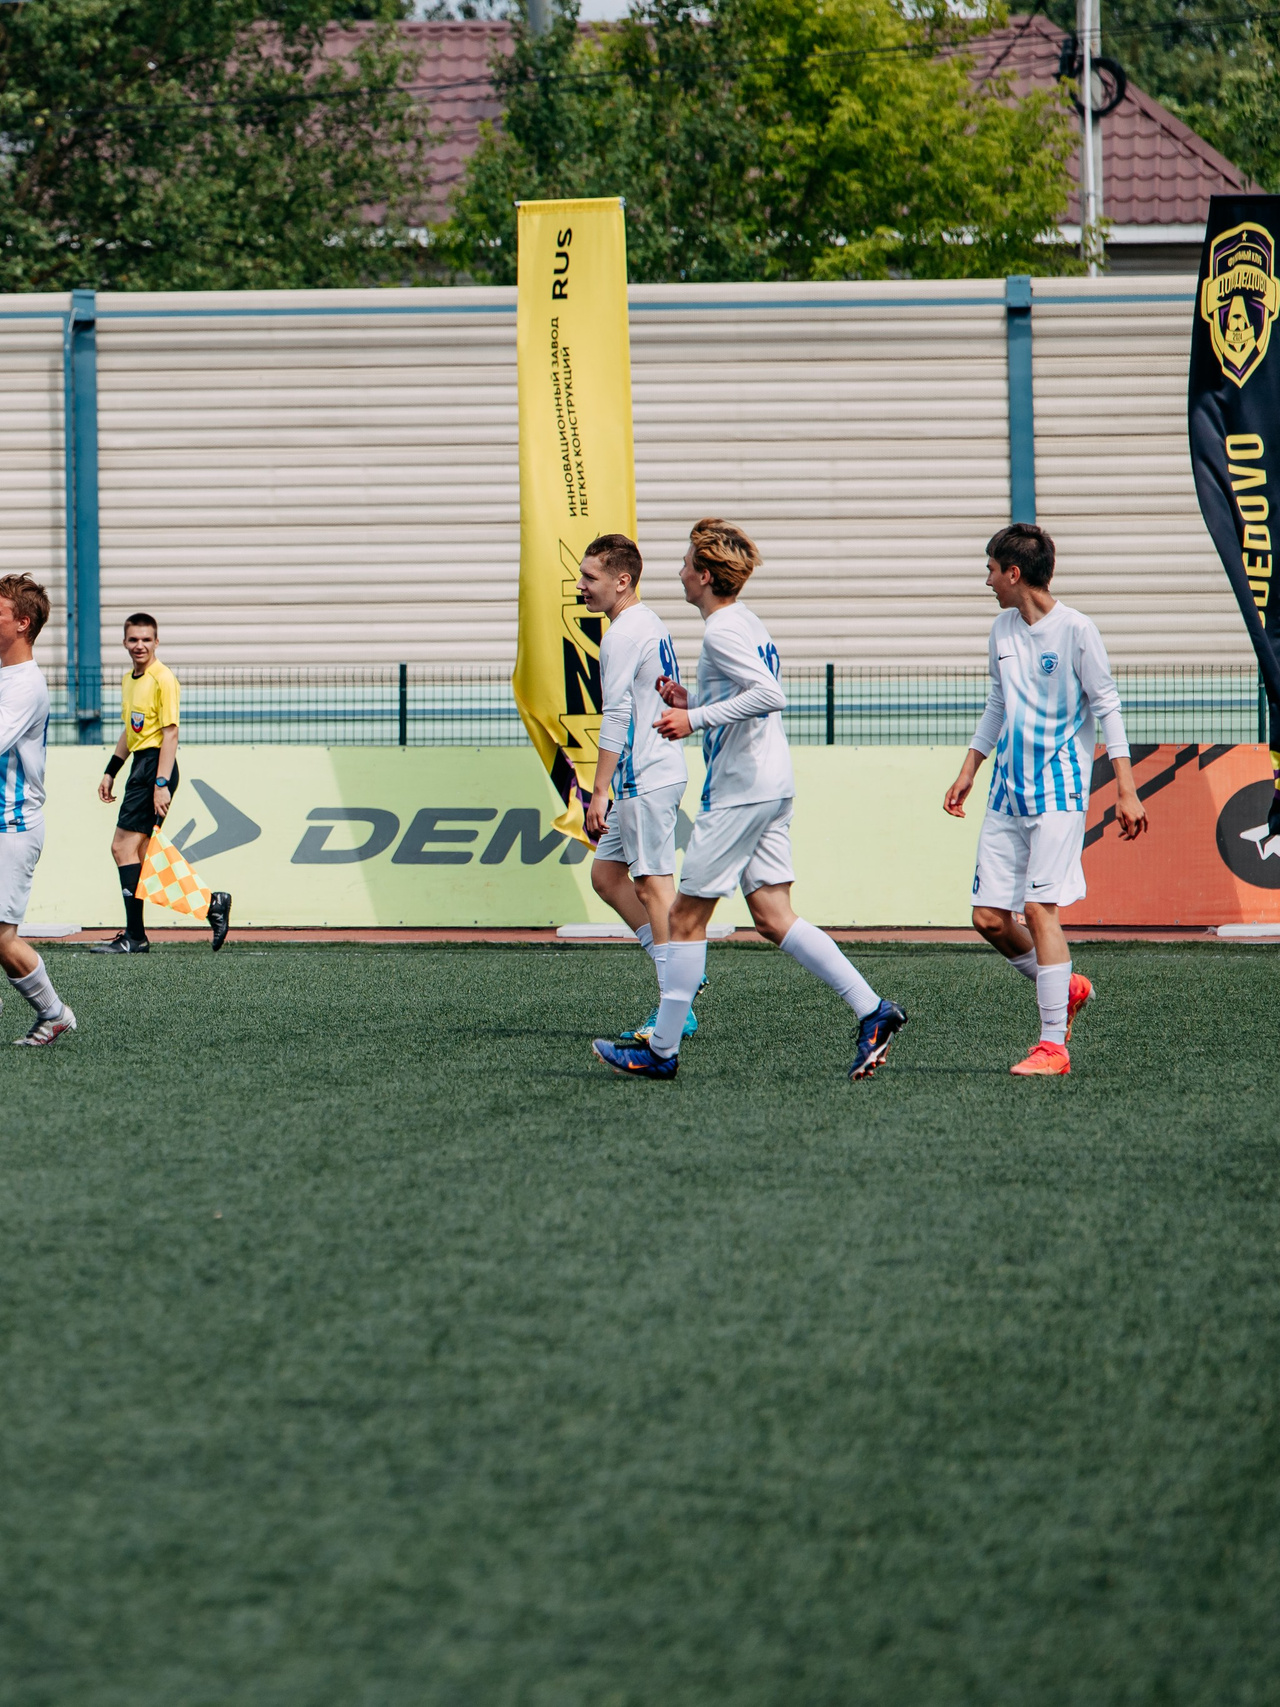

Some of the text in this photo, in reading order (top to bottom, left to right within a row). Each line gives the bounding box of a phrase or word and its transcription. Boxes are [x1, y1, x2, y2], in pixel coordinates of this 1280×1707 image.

[552, 227, 572, 300] RUS
[1218, 271, 1267, 297] ДОДЕДОВО
[551, 316, 577, 517] ИННОВАЦИОННЫЙ ЗАВОД
[560, 346, 589, 517] ЛЕГКИХ КОНСТРУКЦИЙ
[290, 807, 697, 865] DEM
